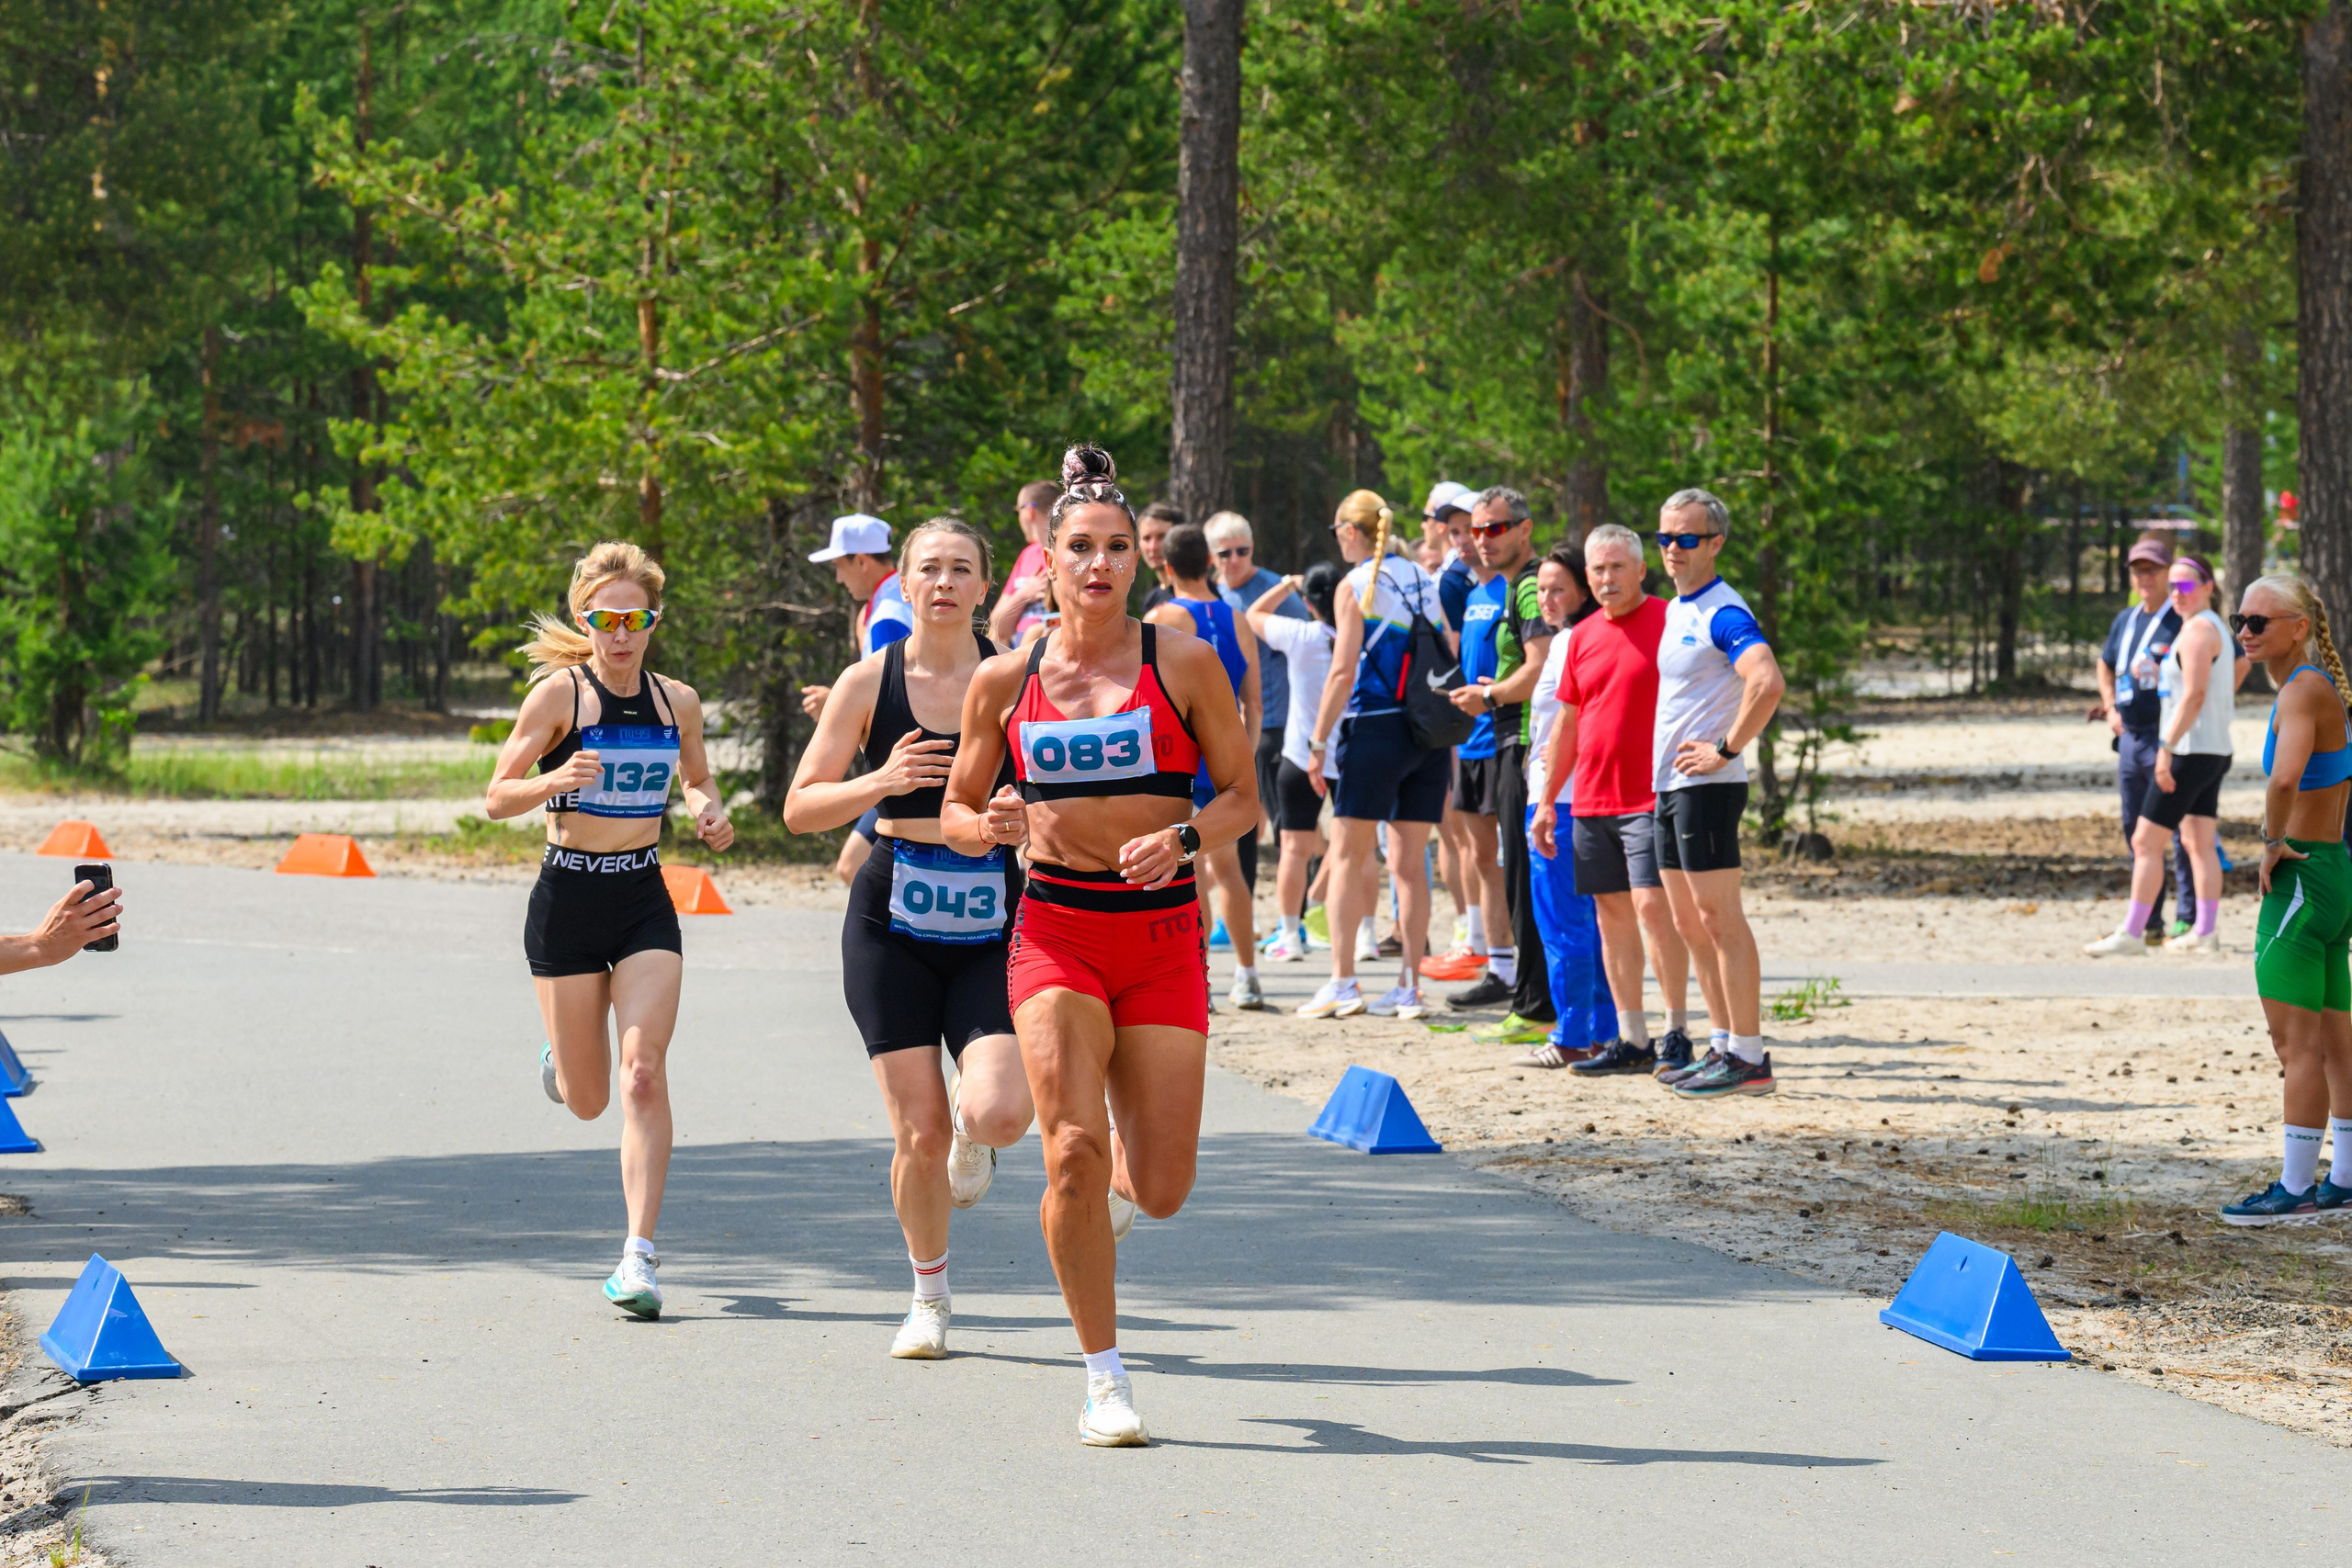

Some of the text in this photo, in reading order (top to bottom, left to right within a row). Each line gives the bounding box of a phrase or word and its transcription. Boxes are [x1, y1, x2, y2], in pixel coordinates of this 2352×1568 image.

[1033, 729, 1141, 772] 083
[602, 762, 670, 792] 132
[903, 880, 997, 919] 043
[1148, 911, 1192, 942] ГТО
